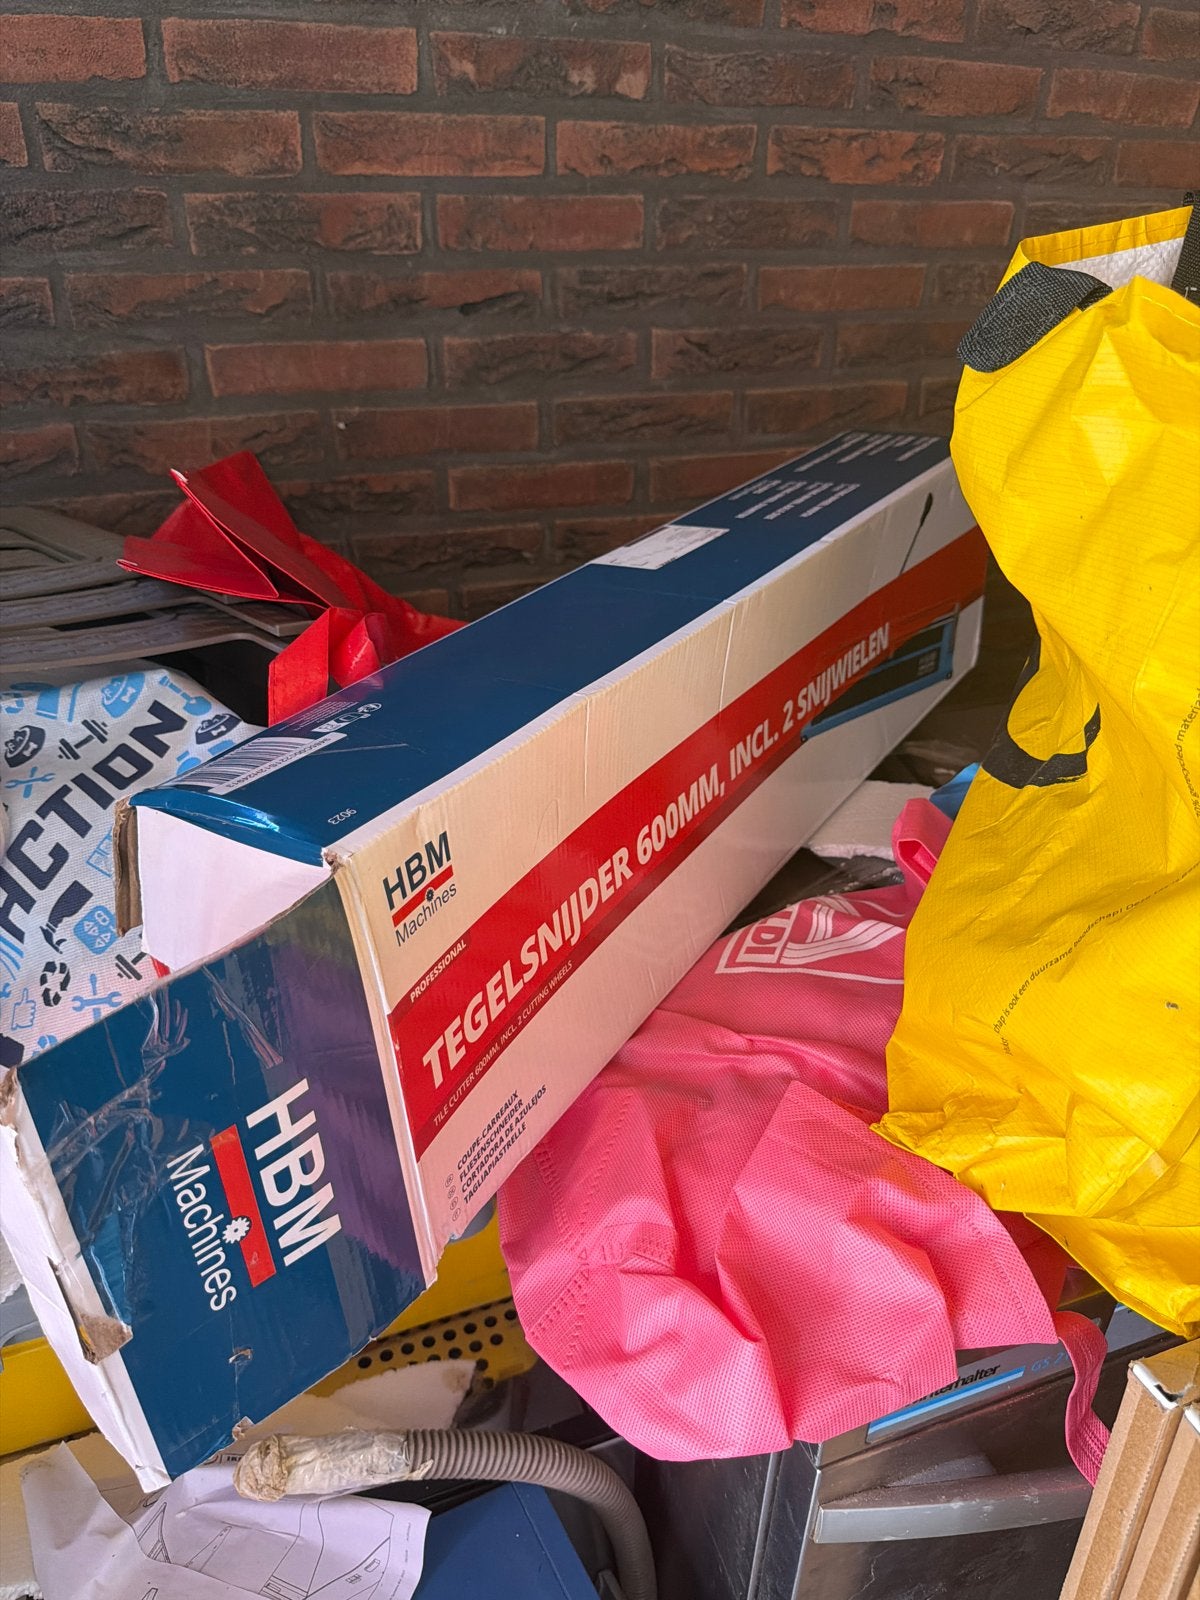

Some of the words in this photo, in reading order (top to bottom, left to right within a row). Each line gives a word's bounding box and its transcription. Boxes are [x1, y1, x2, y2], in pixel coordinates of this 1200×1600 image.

[1176, 687, 1200, 742] materia
[327, 807, 357, 825] 9023
[422, 847, 634, 1090] TEGELSNIJDER
[636, 764, 725, 866] 600MM,
[729, 719, 779, 781] INCL.
[782, 699, 794, 735] 2
[796, 622, 890, 722] SNIJWIELEN
[382, 830, 452, 911] HBM
[395, 883, 457, 947] Machines
[743, 910, 793, 955] LDI
[410, 939, 467, 1003] PROFESSIONAL
[1008, 993, 1020, 1010] ook
[1018, 979, 1030, 996] een
[1029, 947, 1073, 981] duurzame
[433, 1104, 449, 1127] TILE
[448, 1073, 475, 1108] CUTTER
[474, 1045, 501, 1076] 600MM,
[517, 1015, 523, 1026] 2
[522, 984, 549, 1020] CUTTING
[548, 959, 573, 989] WHEELS
[457, 1090, 519, 1170] COUPE-CARREAUX
[459, 1099, 523, 1182] FLIESENSCHNEIDER
[461, 1136, 504, 1193] CORTADORA
[504, 1123, 515, 1138] DE
[514, 1084, 547, 1127] AZULEJOS
[463, 1121, 527, 1204] TAGLIAPIASTRELLE
[245, 1077, 342, 1267] HBM
[166, 1143, 238, 1311] Machines
